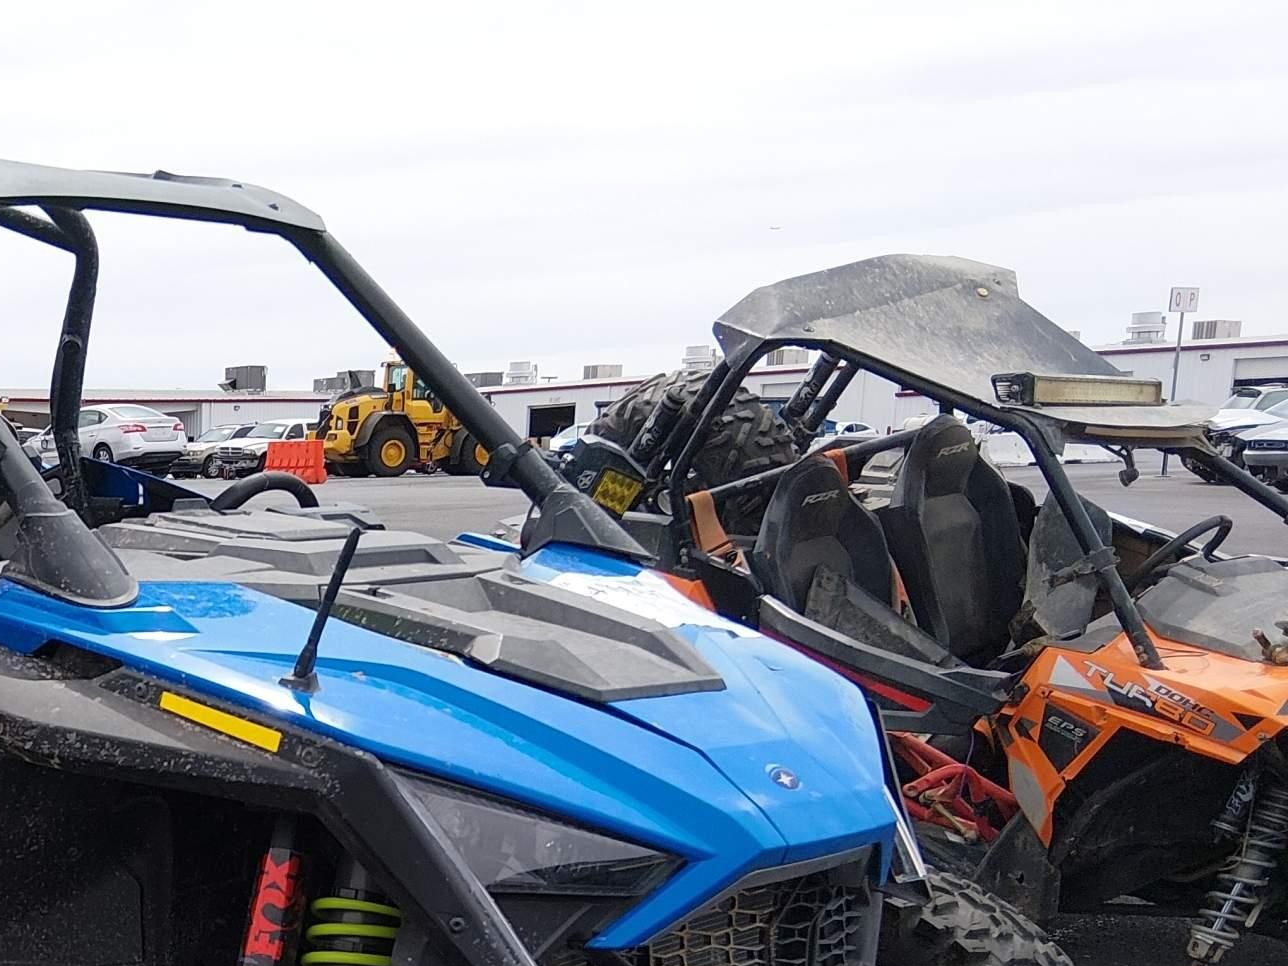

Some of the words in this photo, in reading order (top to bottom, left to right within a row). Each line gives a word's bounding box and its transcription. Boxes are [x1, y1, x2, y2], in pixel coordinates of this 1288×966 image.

[1083, 660, 1216, 736] TURBO
[1154, 684, 1215, 719] DOHC
[1047, 716, 1088, 737] EPS
[243, 850, 300, 960] FOX
